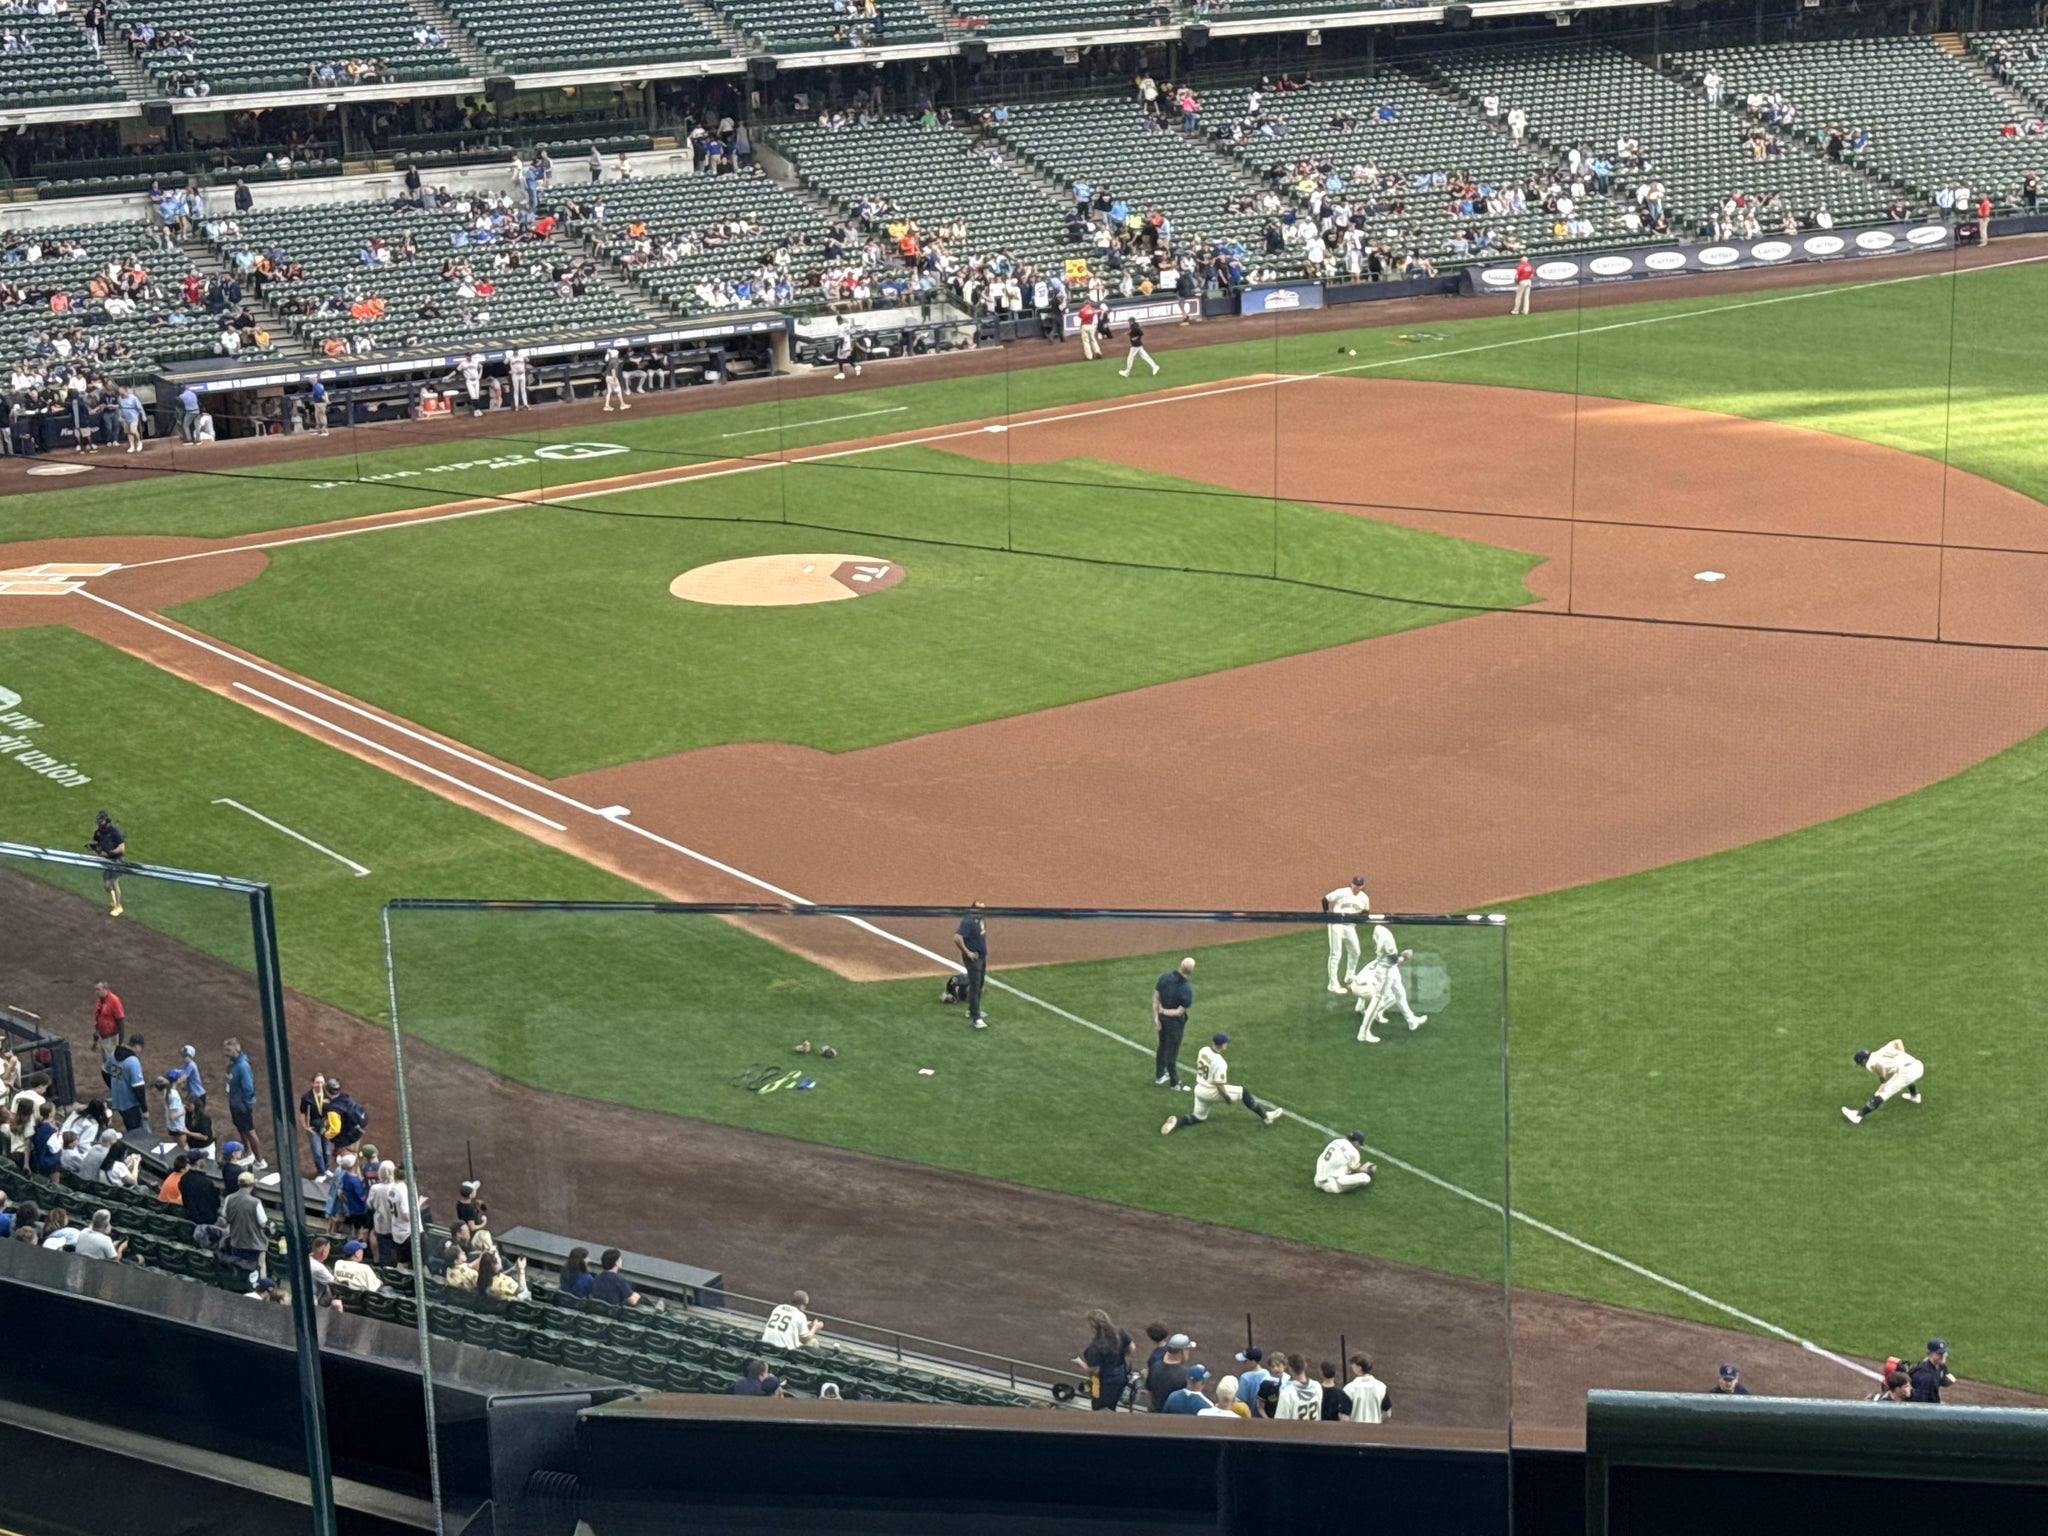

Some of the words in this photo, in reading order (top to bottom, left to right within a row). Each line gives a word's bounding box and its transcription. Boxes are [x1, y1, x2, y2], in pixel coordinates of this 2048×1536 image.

[1115, 307, 1148, 322] AMERICAN
[1149, 304, 1172, 318] FAMILY
[395, 340, 505, 358] FAMILY
[300, 352, 390, 367] FIELD
[14, 750, 92, 788] union
[1324, 1146, 1336, 1162] 6
[768, 1313, 792, 1333] 25
[1298, 1401, 1319, 1420] 22
